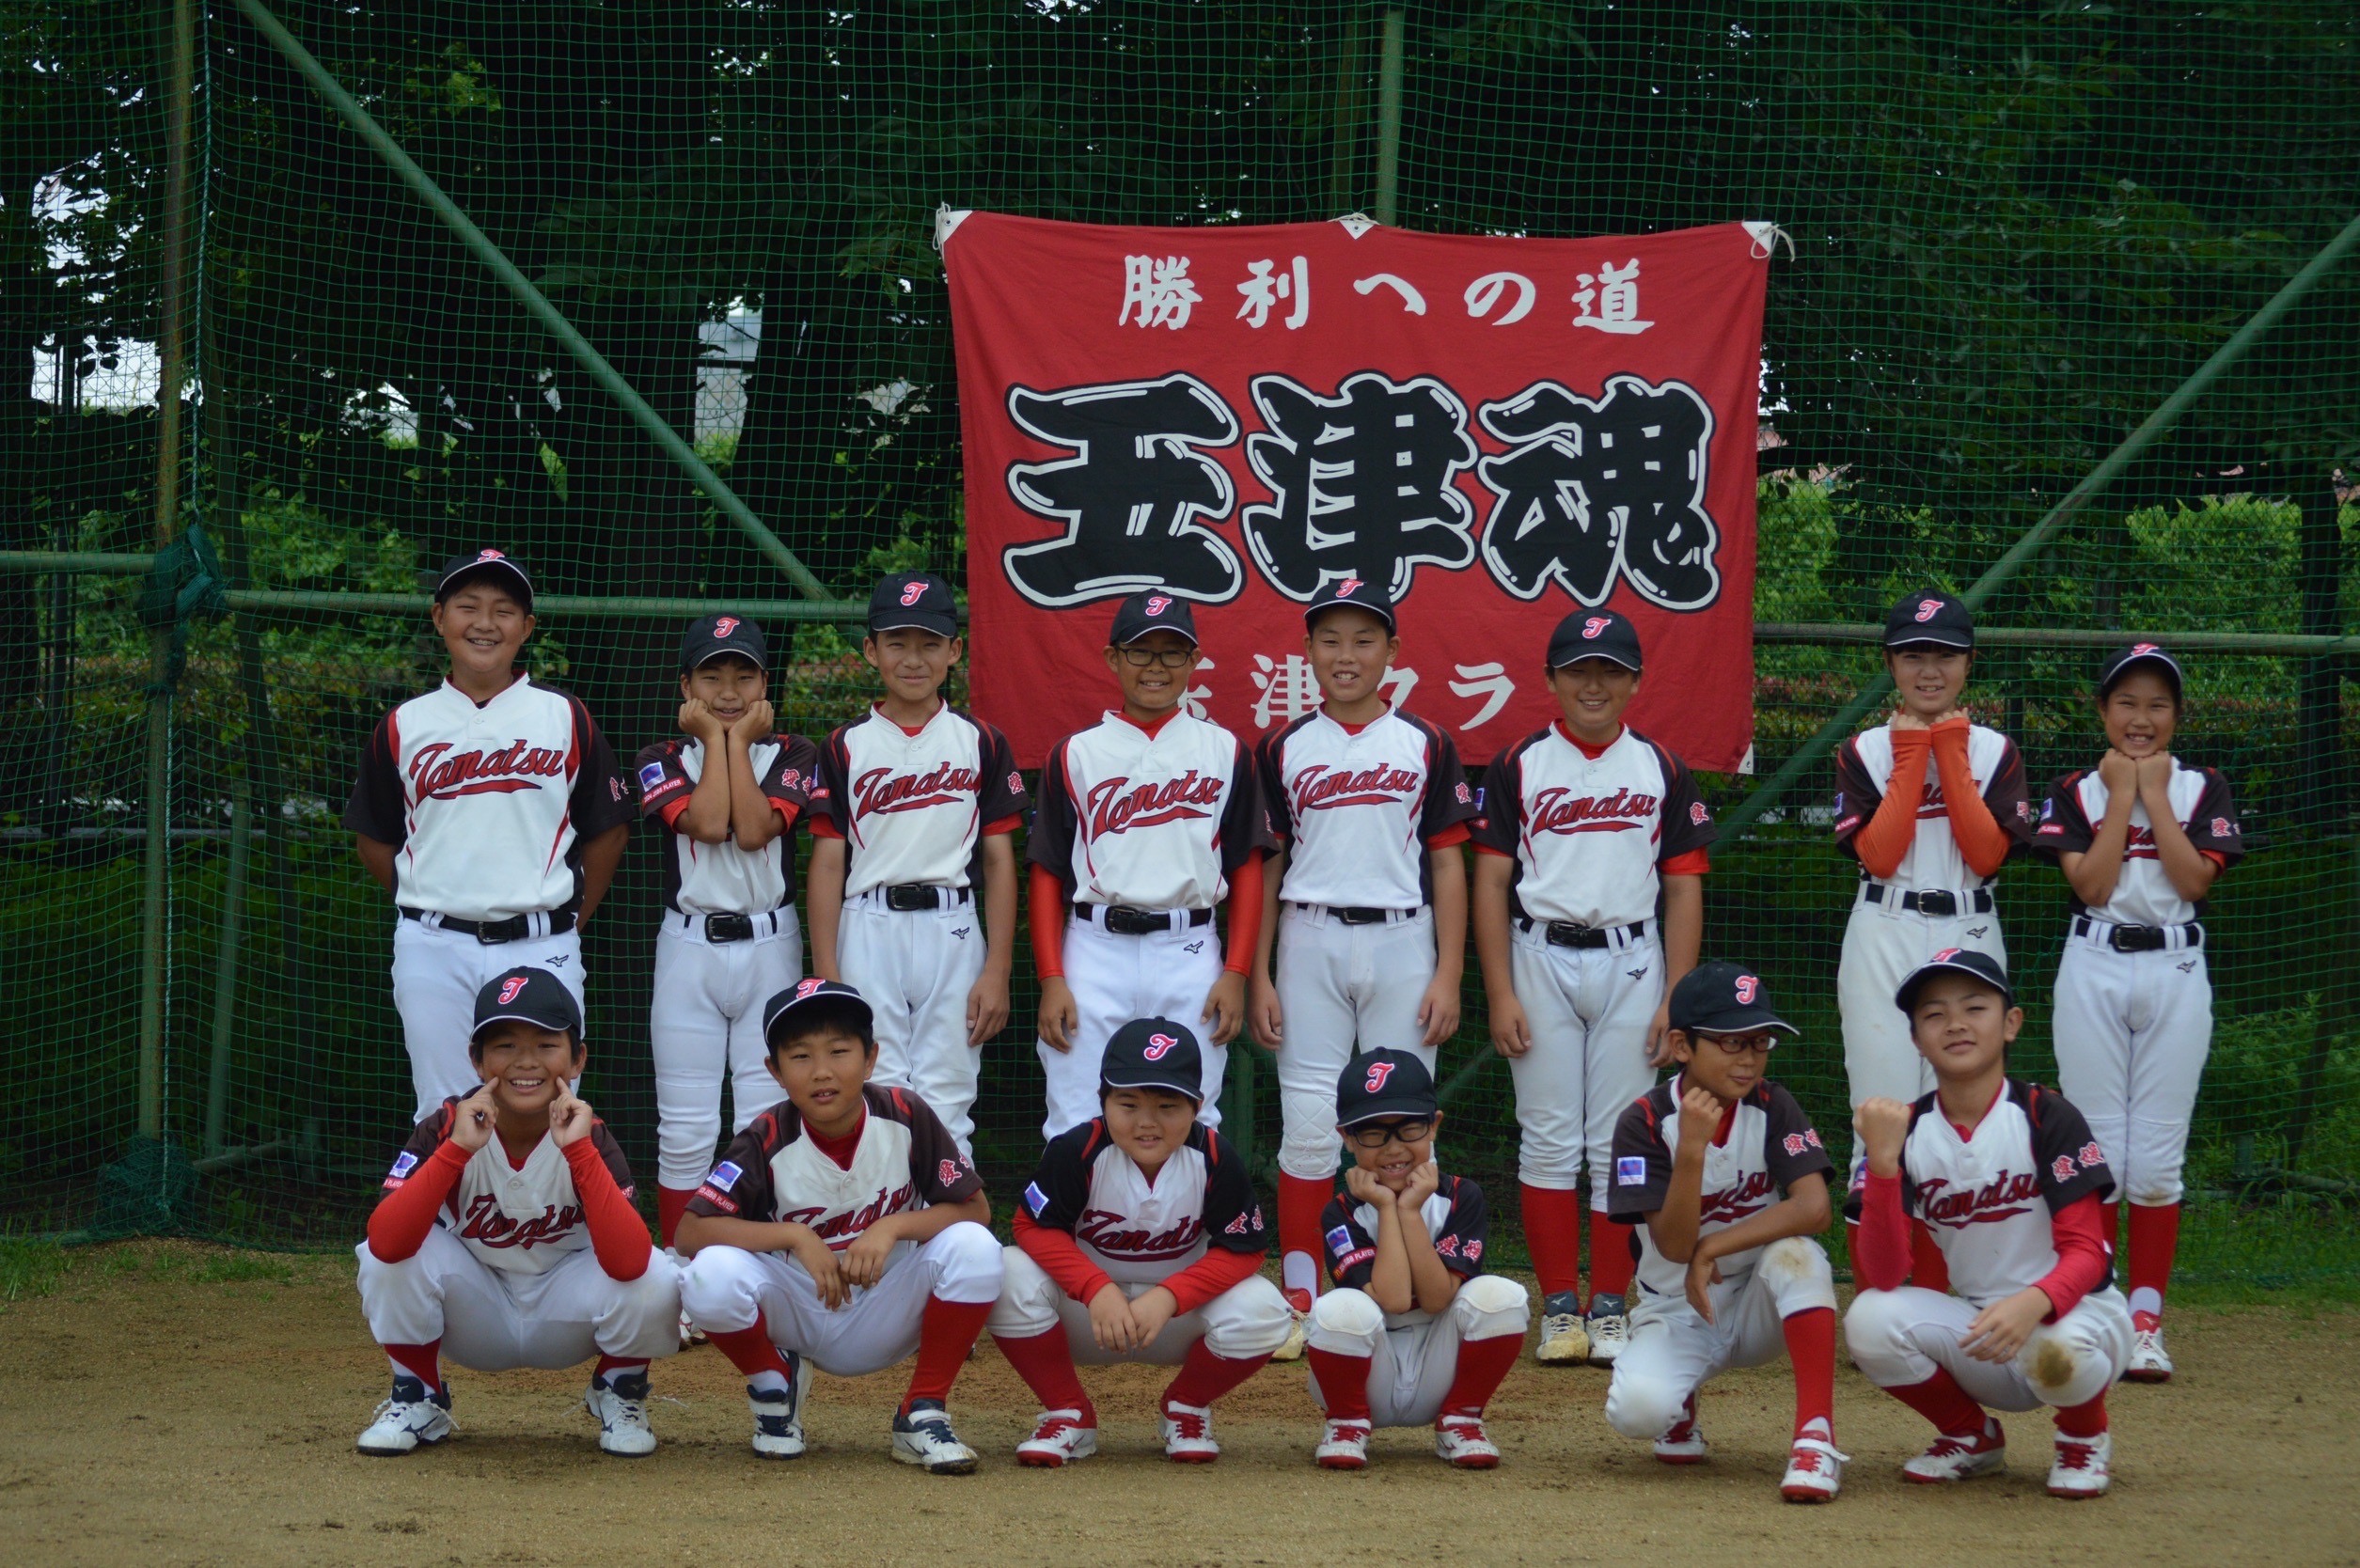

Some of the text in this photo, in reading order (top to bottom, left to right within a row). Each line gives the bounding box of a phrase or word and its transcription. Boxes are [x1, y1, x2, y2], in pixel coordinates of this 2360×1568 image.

[1119, 254, 1655, 335] 勝利への道
[1001, 368, 1722, 611] 玉津魂
[408, 739, 564, 808] Tamatsu
[854, 761, 982, 822] Tamatsu
[1292, 762, 1418, 817] Tamatsu
[1530, 787, 1657, 838] Tamatsu
[716, 1196, 735, 1212] PLAYER
[1915, 1169, 2041, 1230] Tamatsu
[1354, 1248, 1376, 1260] PLAYER
